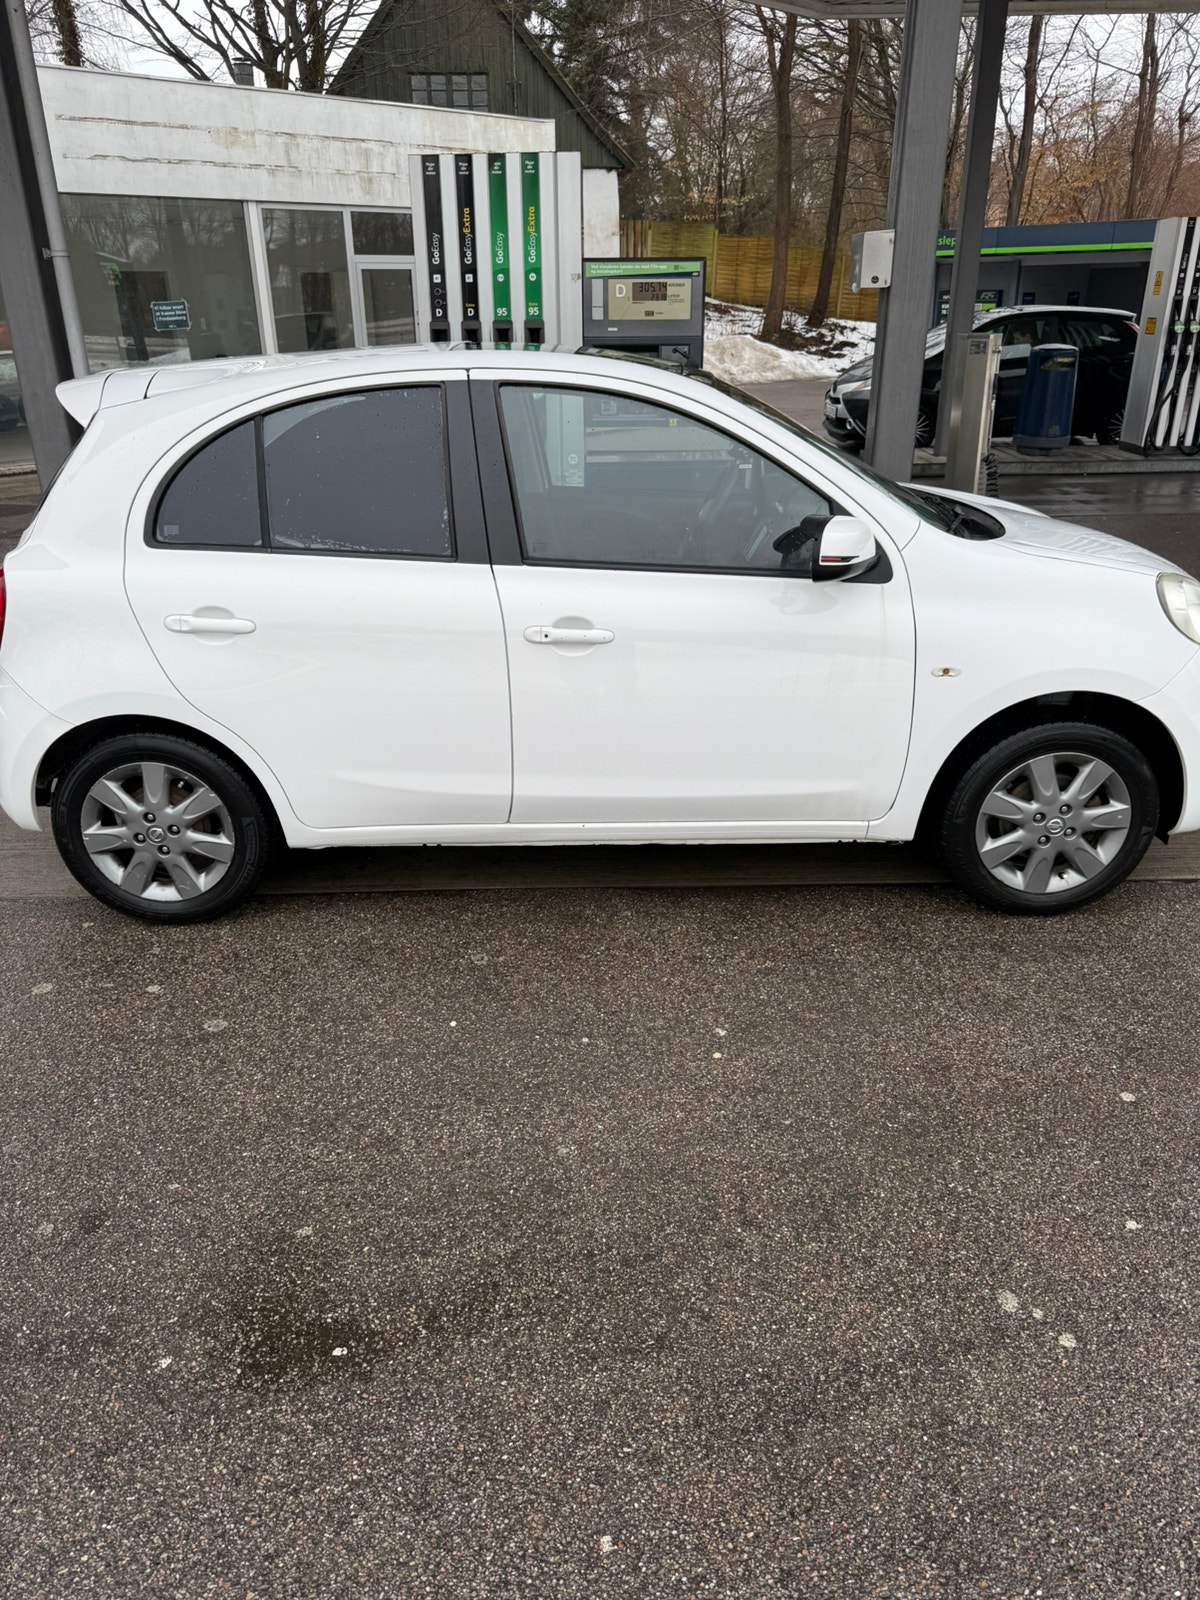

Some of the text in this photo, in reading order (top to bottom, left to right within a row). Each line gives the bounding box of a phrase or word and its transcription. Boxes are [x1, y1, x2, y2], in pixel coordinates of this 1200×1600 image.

[463, 208, 473, 264] GoEasyExtra
[528, 206, 537, 263] GoEasyExtra
[432, 232, 440, 264] GoEasy
[496, 232, 504, 264] GoEasy
[616, 284, 626, 298] D
[639, 282, 667, 292] 305.74
[496, 308, 508, 316] 95
[528, 307, 539, 315] 95
